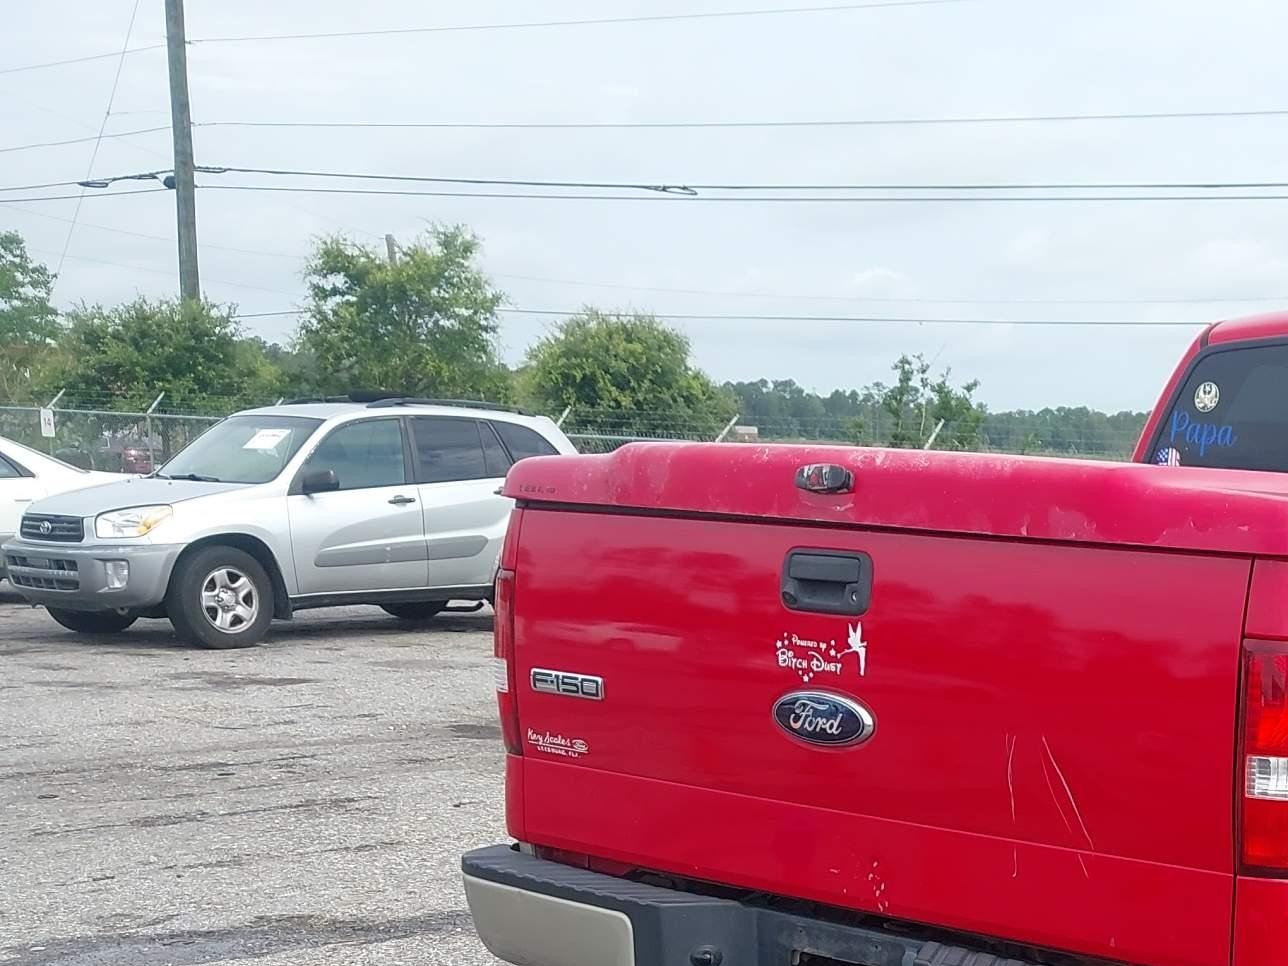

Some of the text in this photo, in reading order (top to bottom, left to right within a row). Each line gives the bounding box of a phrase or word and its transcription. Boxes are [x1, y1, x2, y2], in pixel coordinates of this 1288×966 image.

[1170, 410, 1236, 457] Papa
[532, 670, 600, 698] F-150
[787, 699, 843, 735] Ford
